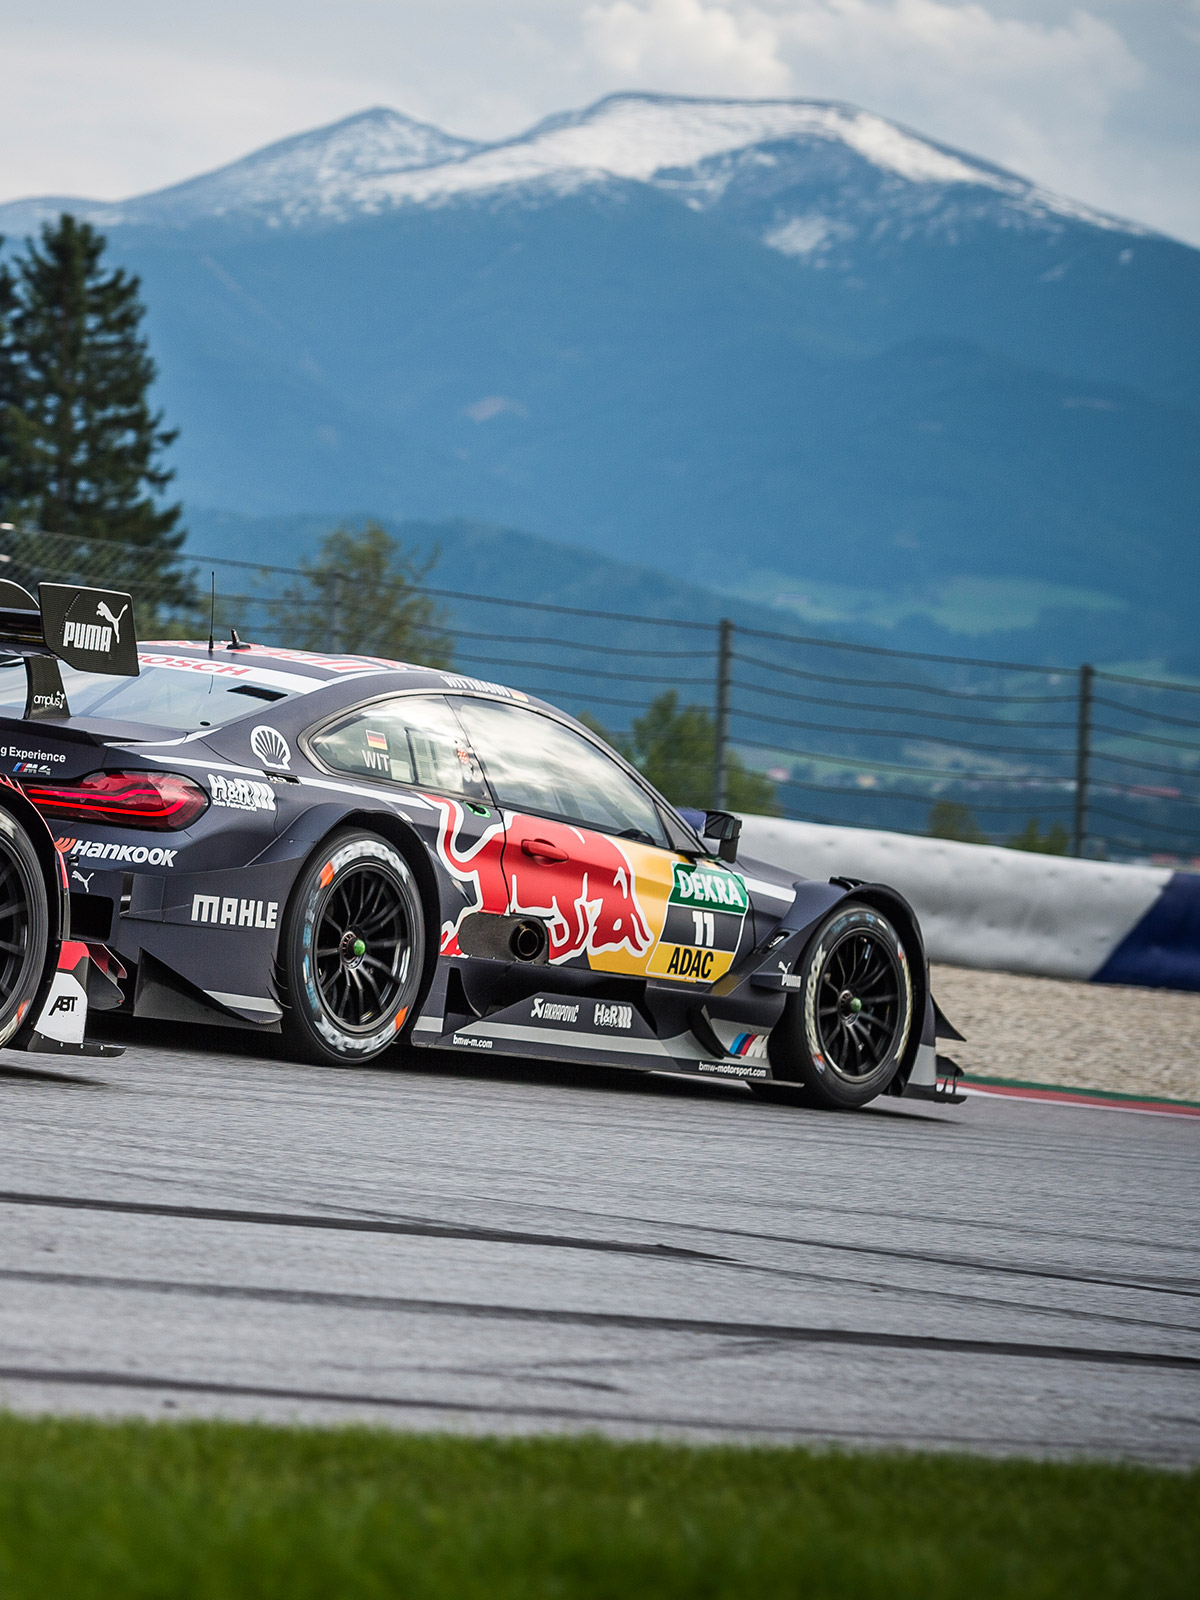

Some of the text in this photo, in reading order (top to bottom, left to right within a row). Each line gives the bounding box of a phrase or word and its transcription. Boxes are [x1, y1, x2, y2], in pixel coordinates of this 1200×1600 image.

[63, 621, 112, 652] PUMA
[137, 655, 251, 675] OSCH
[33, 693, 60, 708] amplus
[9, 746, 66, 762] Experience
[362, 749, 389, 771] WIT
[676, 869, 744, 907] DEKRA
[191, 894, 278, 929] MAHLE
[692, 910, 715, 947] 11
[667, 947, 714, 979] ADAC
[48, 995, 78, 1016] ABT
[453, 1034, 492, 1048] bmw-m.com
[699, 1062, 766, 1077] bmw-motorsport.com
